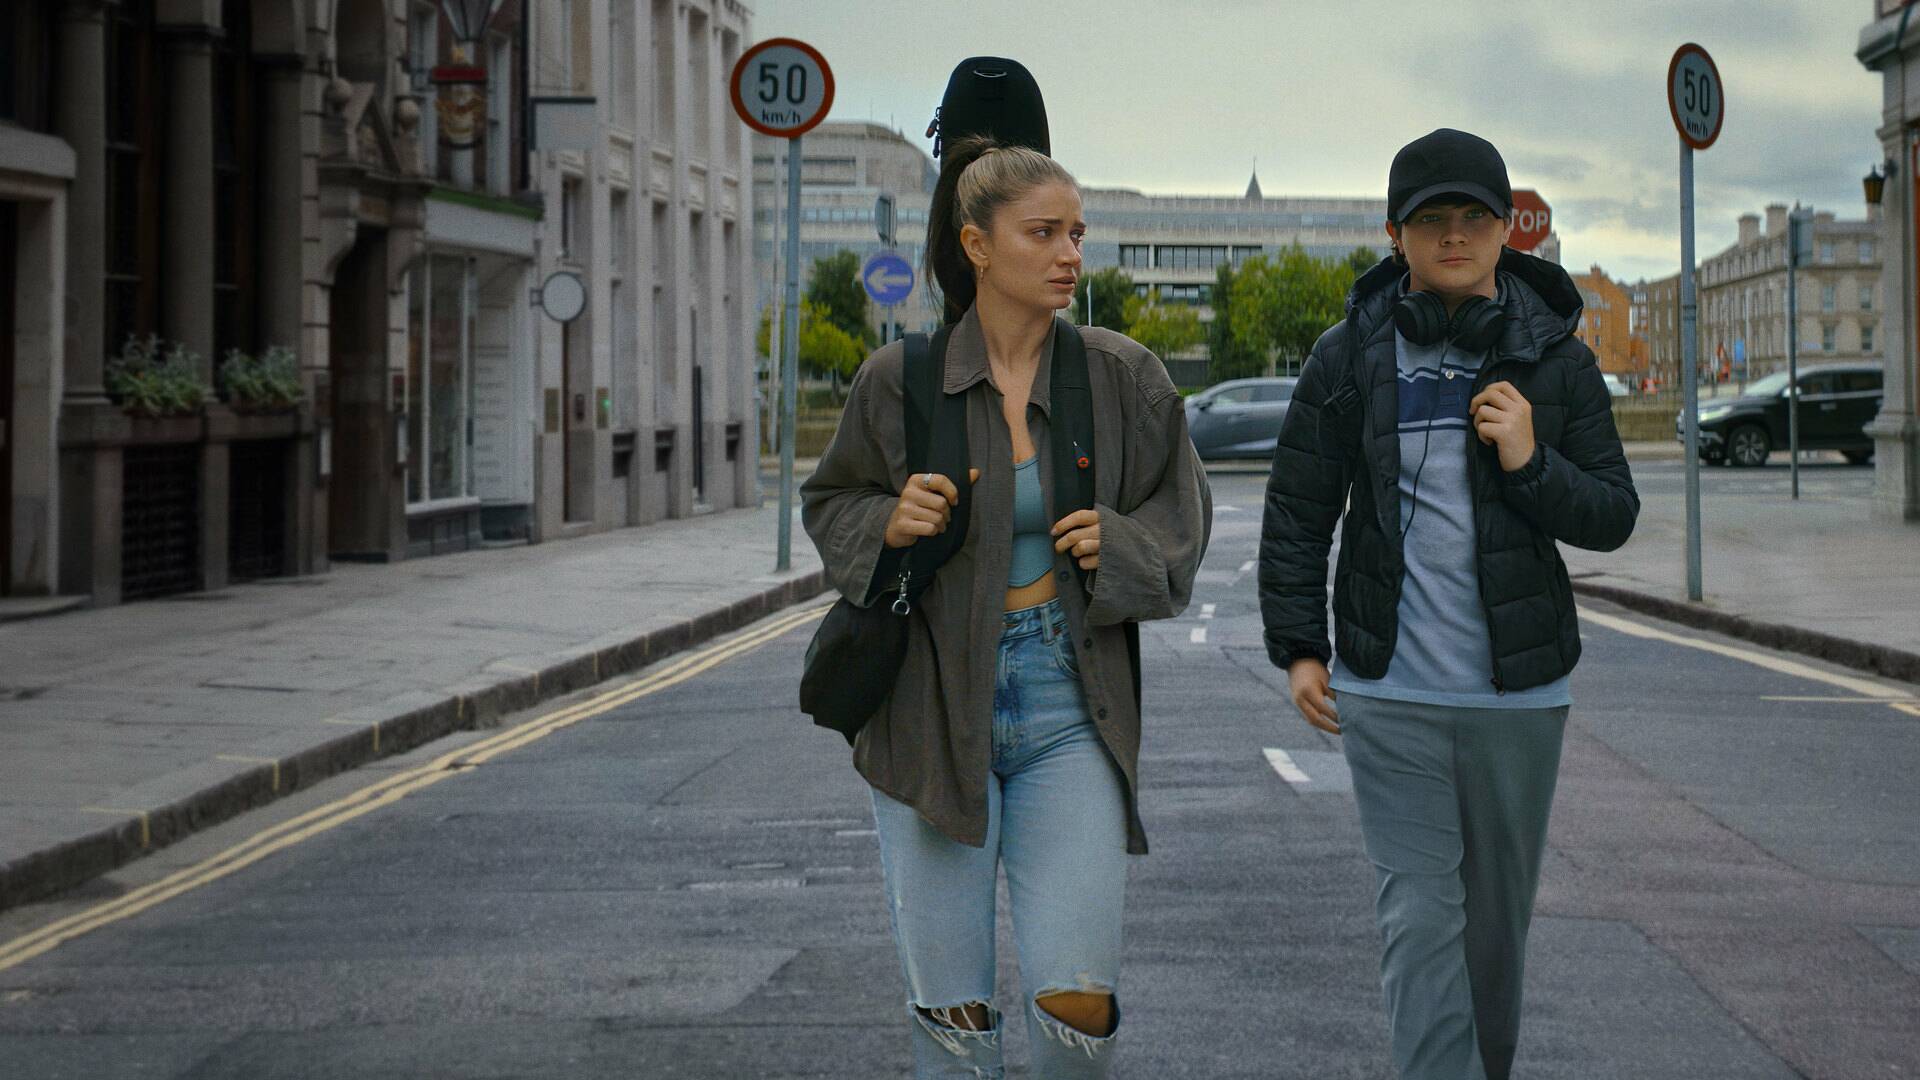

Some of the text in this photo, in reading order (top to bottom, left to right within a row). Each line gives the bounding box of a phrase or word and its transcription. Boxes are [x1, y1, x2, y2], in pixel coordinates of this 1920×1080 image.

[759, 63, 807, 105] 50
[1684, 67, 1710, 117] 50
[761, 107, 801, 125] km/h
[1685, 116, 1708, 137] km/h
[1509, 208, 1549, 233] TOP
